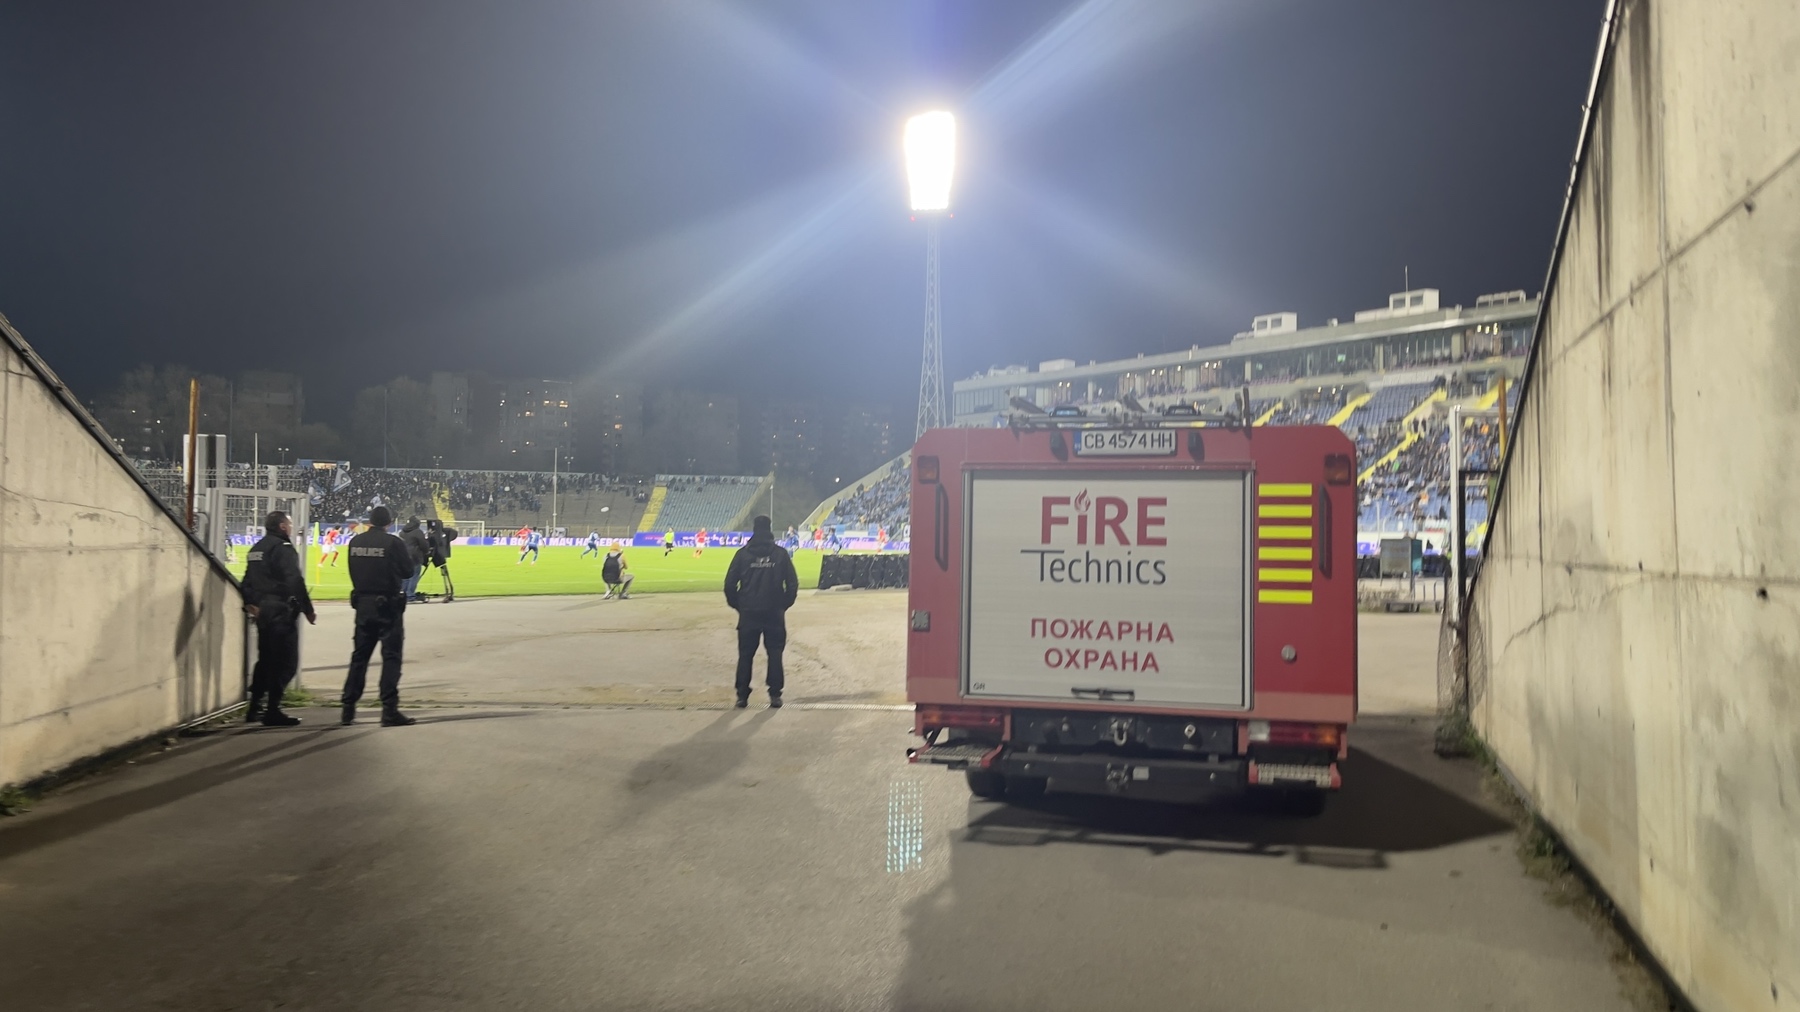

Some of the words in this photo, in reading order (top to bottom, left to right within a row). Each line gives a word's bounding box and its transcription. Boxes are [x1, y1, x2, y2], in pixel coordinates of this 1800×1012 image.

[1108, 433, 1147, 449] 4574
[351, 547, 385, 557] POLICE
[1020, 549, 1166, 585] Technics
[1031, 617, 1174, 644] ПОЖАРНА
[1044, 648, 1160, 673] ОХРАНА
